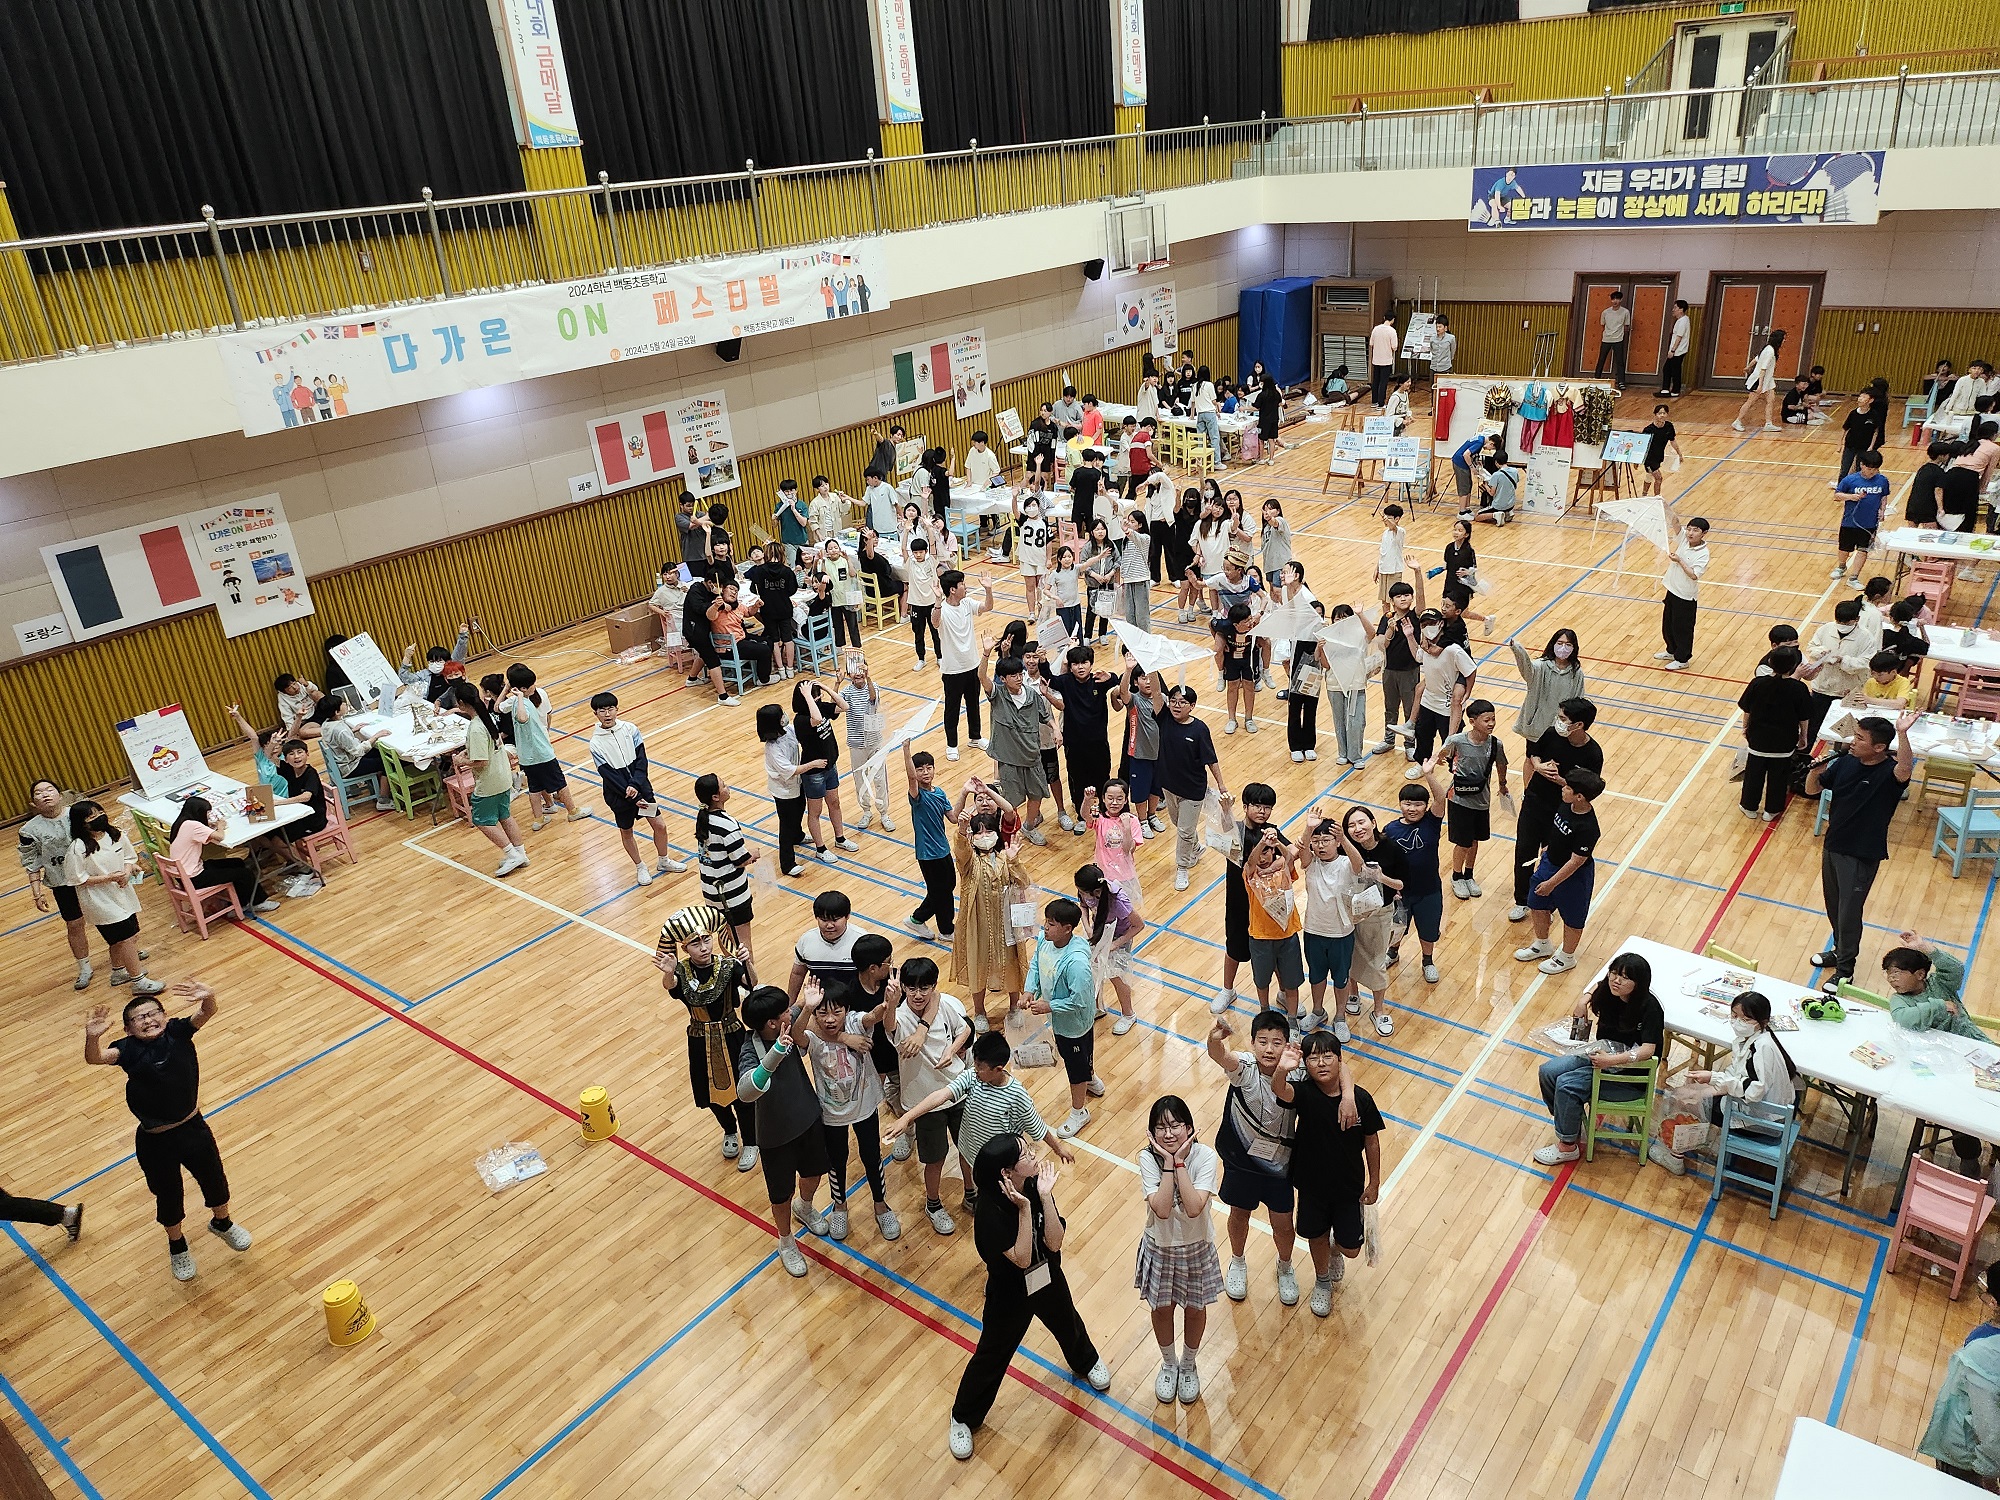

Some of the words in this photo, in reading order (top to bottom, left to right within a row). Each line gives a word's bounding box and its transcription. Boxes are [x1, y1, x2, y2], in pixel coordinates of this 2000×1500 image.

[894, 0, 906, 30] 메달
[899, 44, 911, 86] 동메달
[1131, 38, 1142, 84] 은메달
[536, 45, 563, 115] 금메달
[1581, 169, 1624, 193] 지금
[1629, 166, 1696, 192] 우리가
[1700, 164, 1748, 190] 흘린
[1511, 196, 1551, 220] 땀과
[1556, 196, 1617, 220] 눈물이
[1623, 193, 1689, 219] 정상에
[1693, 192, 1741, 217] 서게
[1746, 189, 1827, 216] 하리라!
[568, 282, 612, 298] 2024학년
[614, 272, 668, 291] 백동초등학교
[557, 302, 609, 341] ON
[743, 318, 778, 334] 백동초등학교
[778, 316, 796, 330] 체육관
[624, 343, 649, 357] 2024년
[650, 341, 661, 352] 5월
[661, 338, 676, 350] 24일
[677, 334, 697, 347] 금요일
[881, 398, 896, 408] 멕시코
[577, 481, 592, 491] 페루
[1854, 485, 1883, 494] KOREA
[208, 528, 231, 541] 다가온
[231, 525, 244, 535] ON
[1023, 525, 1046, 548] 28
[24, 625, 64, 643] 프랑스
